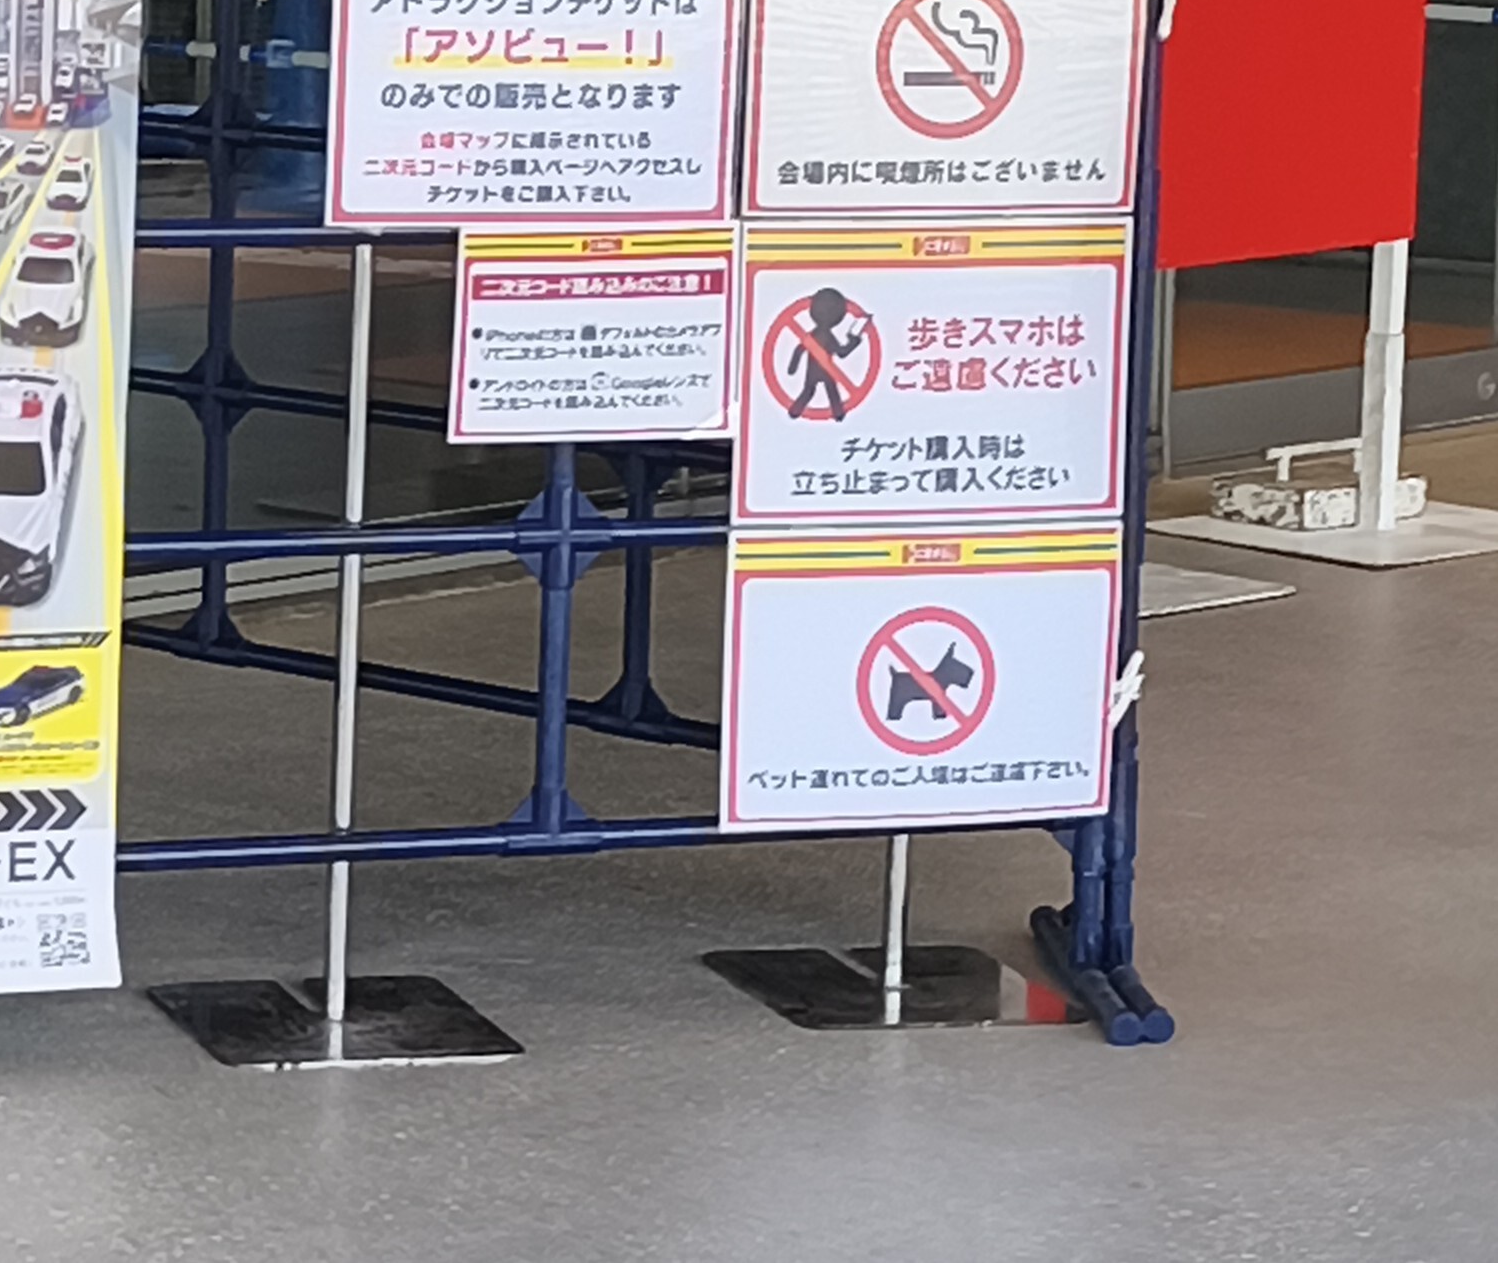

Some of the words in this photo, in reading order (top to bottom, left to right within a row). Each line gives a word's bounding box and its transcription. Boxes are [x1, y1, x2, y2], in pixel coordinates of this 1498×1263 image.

[381, 83, 682, 111] のみでの販売となります
[778, 159, 1106, 185] 会場内に喫煙所はございません
[907, 314, 1085, 350] 歩きスマホは
[891, 356, 1096, 392] ご遠慮ください
[841, 435, 1025, 462] チケット購入時は
[790, 466, 1070, 496] 立ち止まって購入ください
